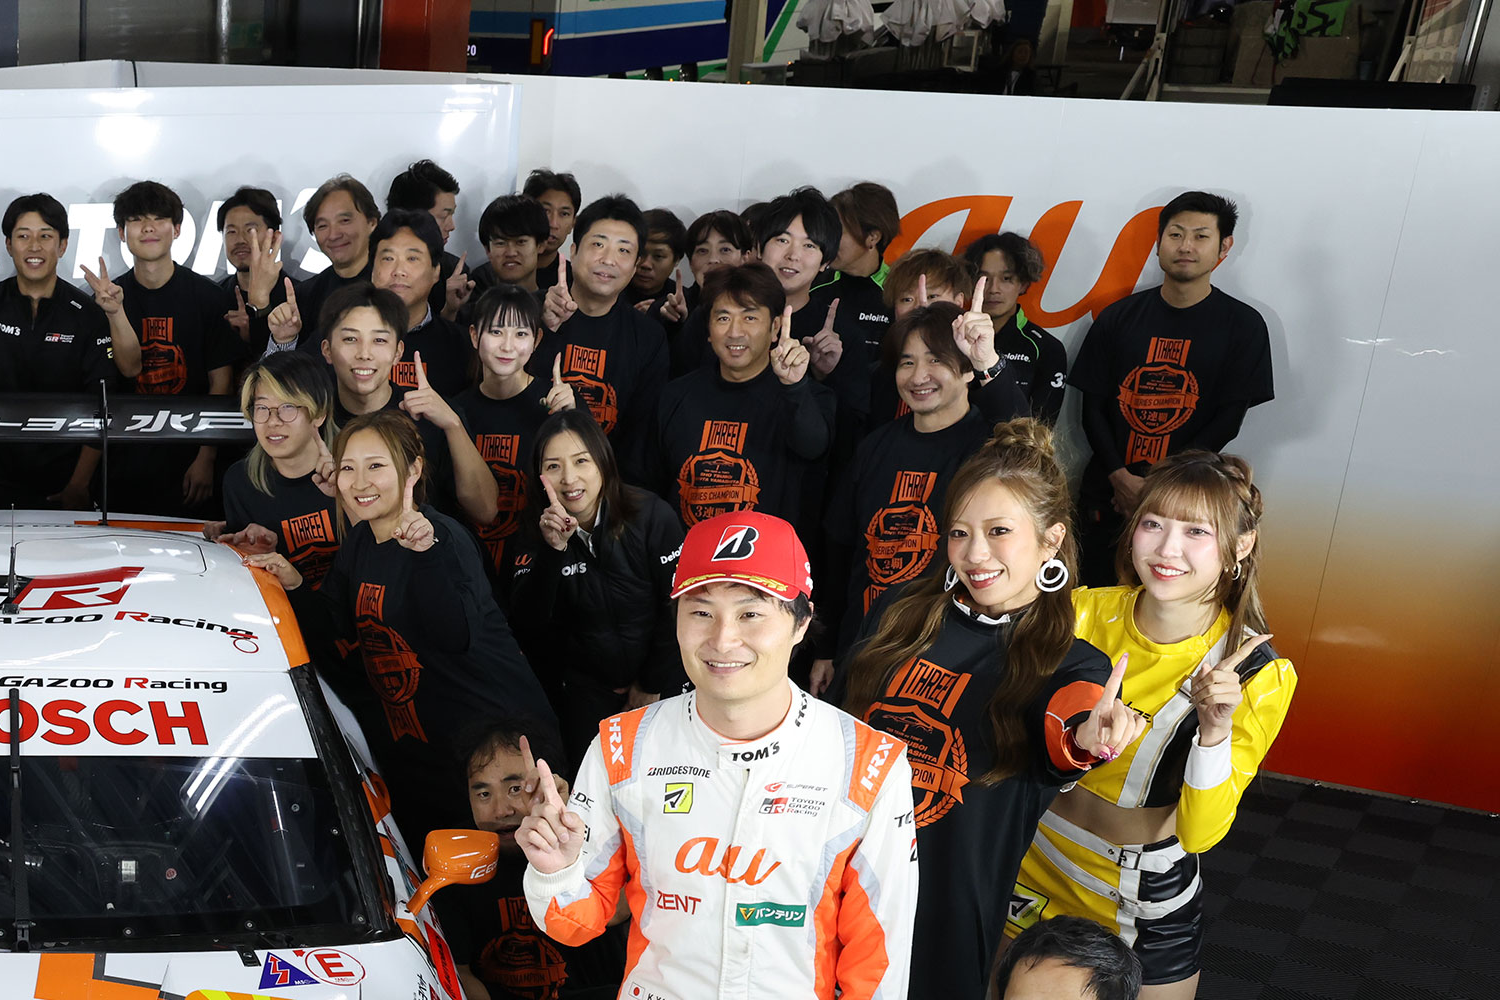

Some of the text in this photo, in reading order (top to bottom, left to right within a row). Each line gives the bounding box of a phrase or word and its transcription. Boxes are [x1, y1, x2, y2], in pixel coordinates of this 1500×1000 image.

[573, 347, 598, 372] THREE
[1158, 340, 1182, 360] THREE
[710, 423, 738, 447] THREE
[484, 435, 511, 460] THREE
[708, 490, 739, 500] CHAMPION
[291, 514, 325, 541] THREE
[124, 677, 229, 693] Racing
[905, 662, 959, 704] THREE
[608, 716, 626, 766] HRX
[731, 740, 780, 763] TOM'S
[647, 765, 711, 779] BRIDGESTONE
[860, 734, 895, 791] HRX
[759, 797, 790, 814] GR
[787, 807, 819, 817] Racing
[788, 803, 821, 811] GAZOO
[790, 797, 826, 806] TOYOTA
[674, 837, 782, 886] au
[656, 890, 702, 915] ZENT
[755, 906, 804, 922] バンテリン
[314, 953, 355, 978] E
